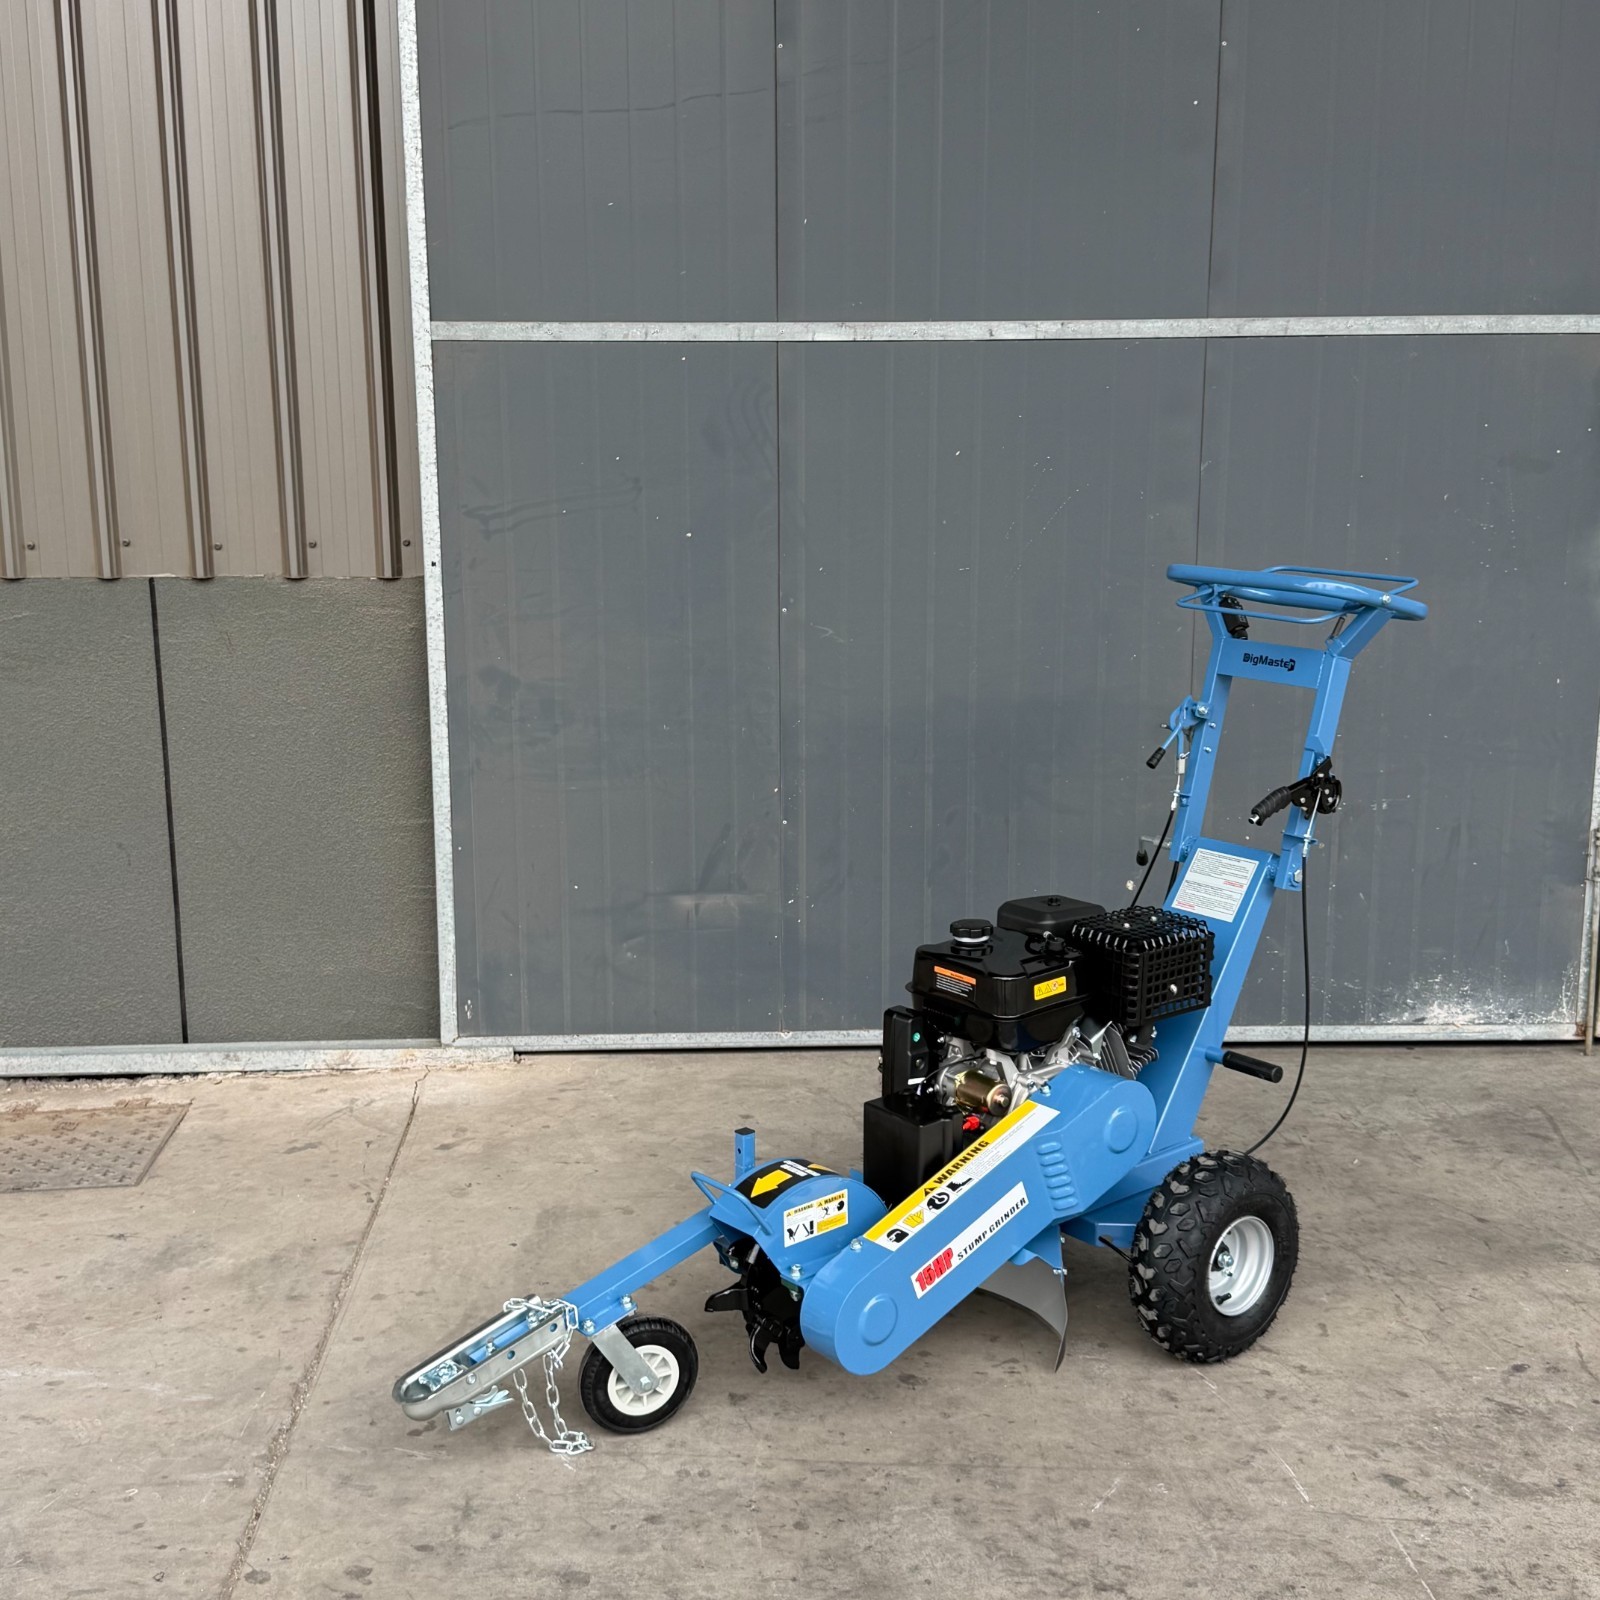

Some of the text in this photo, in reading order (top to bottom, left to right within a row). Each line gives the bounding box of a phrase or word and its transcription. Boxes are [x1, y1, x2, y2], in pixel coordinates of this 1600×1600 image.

[934, 1140, 990, 1185] WARNING
[915, 1197, 1027, 1292] 15HP STUMP GRINDER
